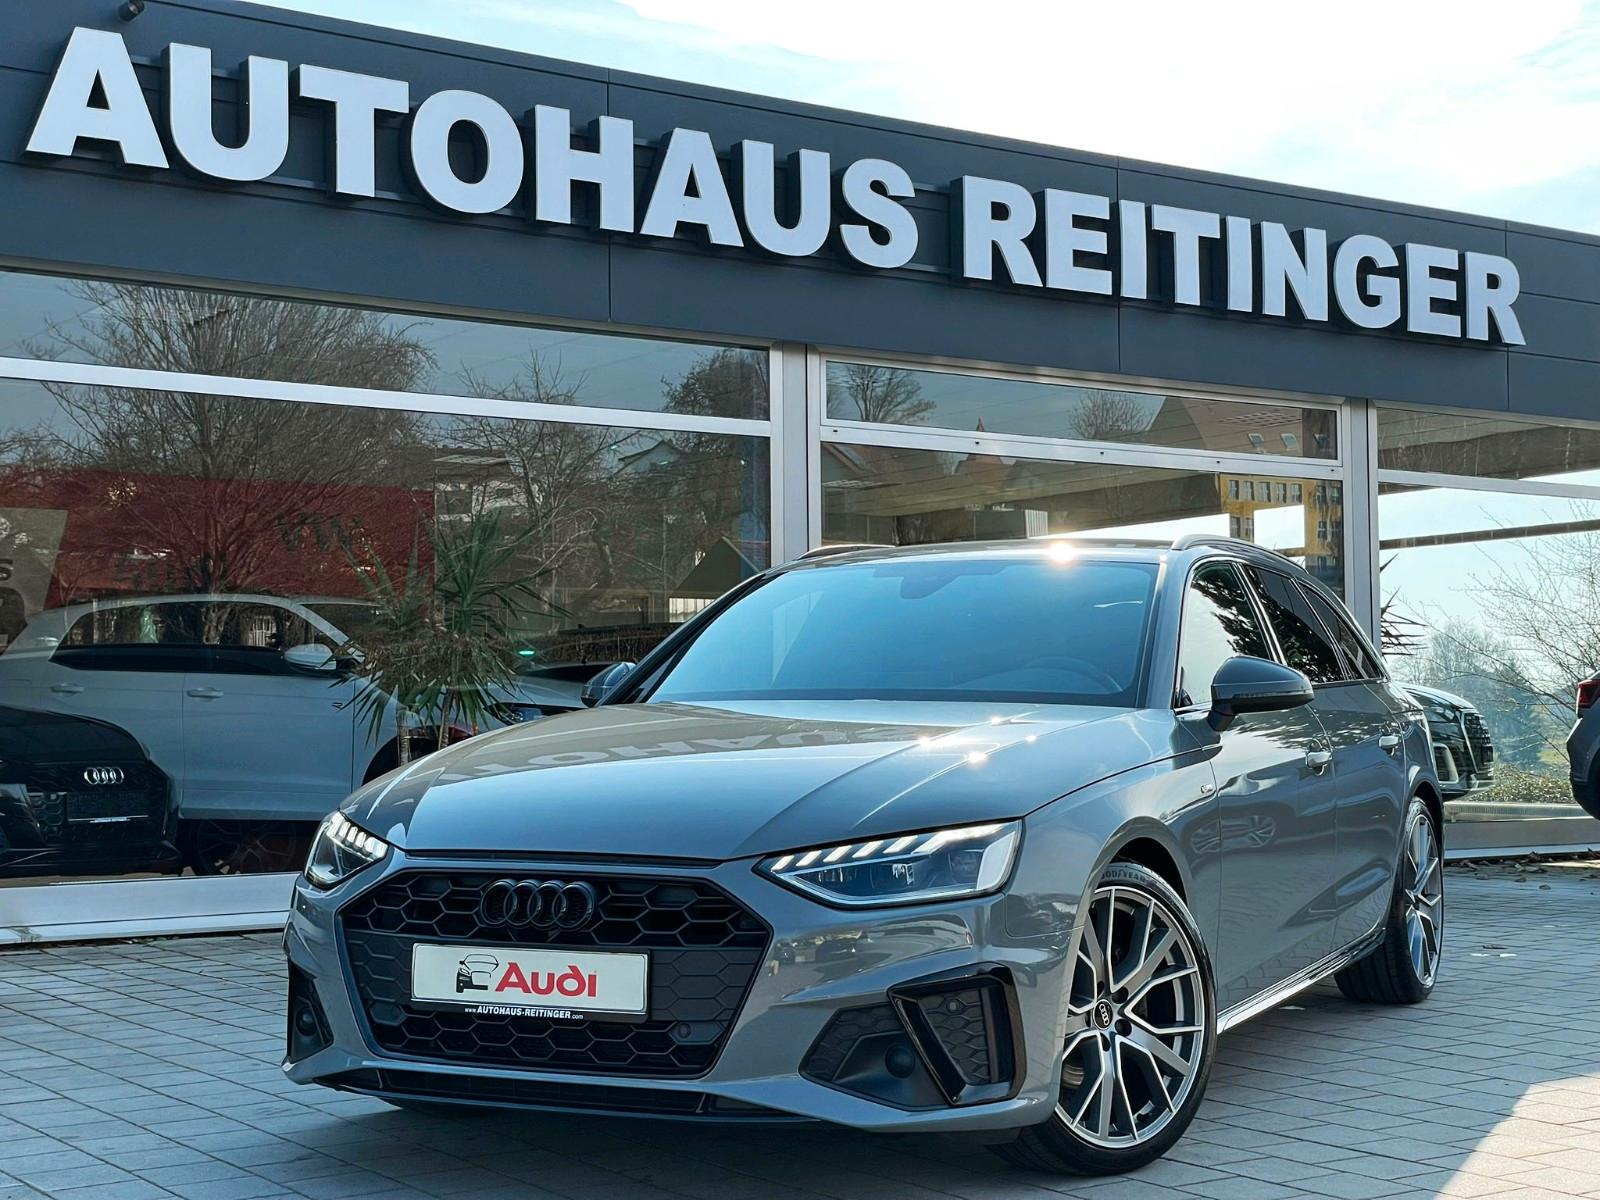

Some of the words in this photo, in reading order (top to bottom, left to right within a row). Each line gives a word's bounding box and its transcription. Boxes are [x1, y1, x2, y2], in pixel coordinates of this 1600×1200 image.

[26, 26, 918, 269] AUTOHAUS
[962, 175, 1526, 345] REITINGER
[495, 961, 597, 997] Audi
